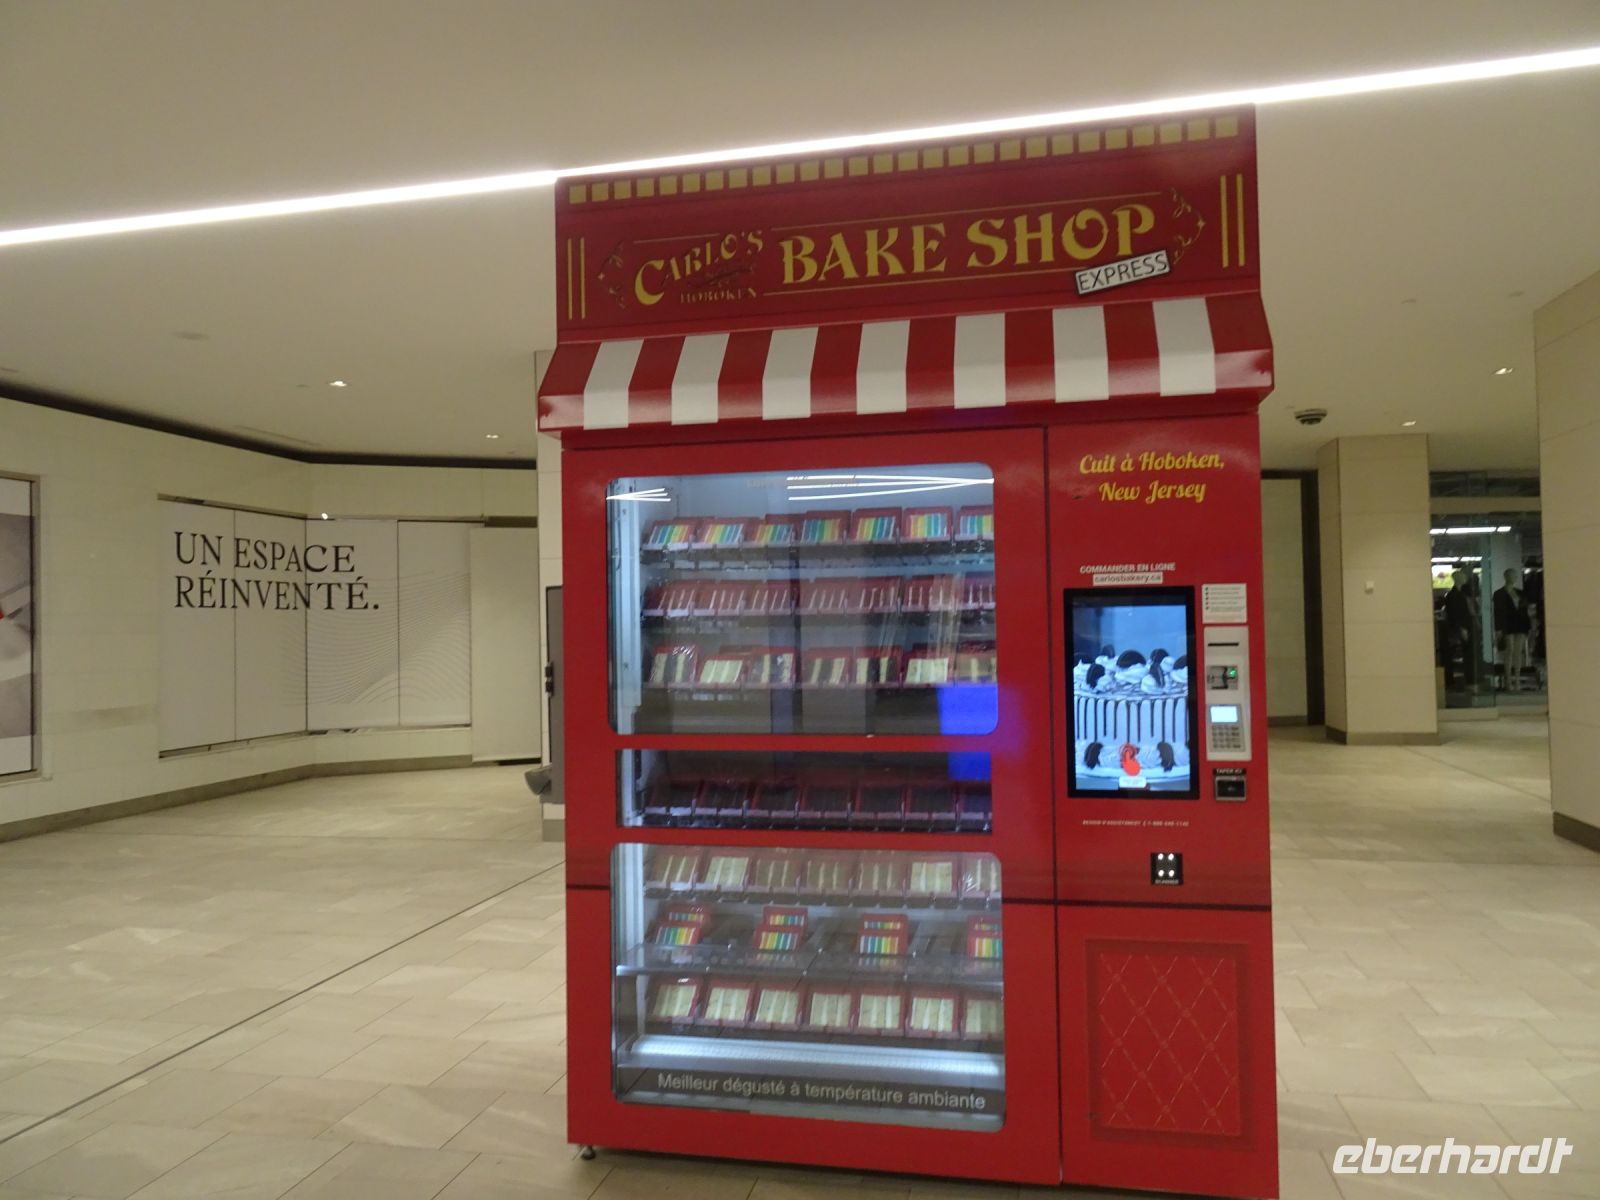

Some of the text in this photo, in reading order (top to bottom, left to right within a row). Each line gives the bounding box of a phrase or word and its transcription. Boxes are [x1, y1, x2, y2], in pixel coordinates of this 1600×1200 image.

[634, 203, 1155, 305] CARLO'S BAKE SHOP
[1077, 252, 1169, 292] EXPRESS
[1079, 450, 1225, 474] Cuit à Hoboken,
[1098, 479, 1207, 504] New Jersey
[174, 531, 356, 573] UN ESPACE
[1080, 562, 1176, 574] COMMANDER EN LIGNE
[174, 569, 380, 610] RÉINVENTÉ.
[657, 1072, 986, 1110] Meilleur dégusté à température ambiante
